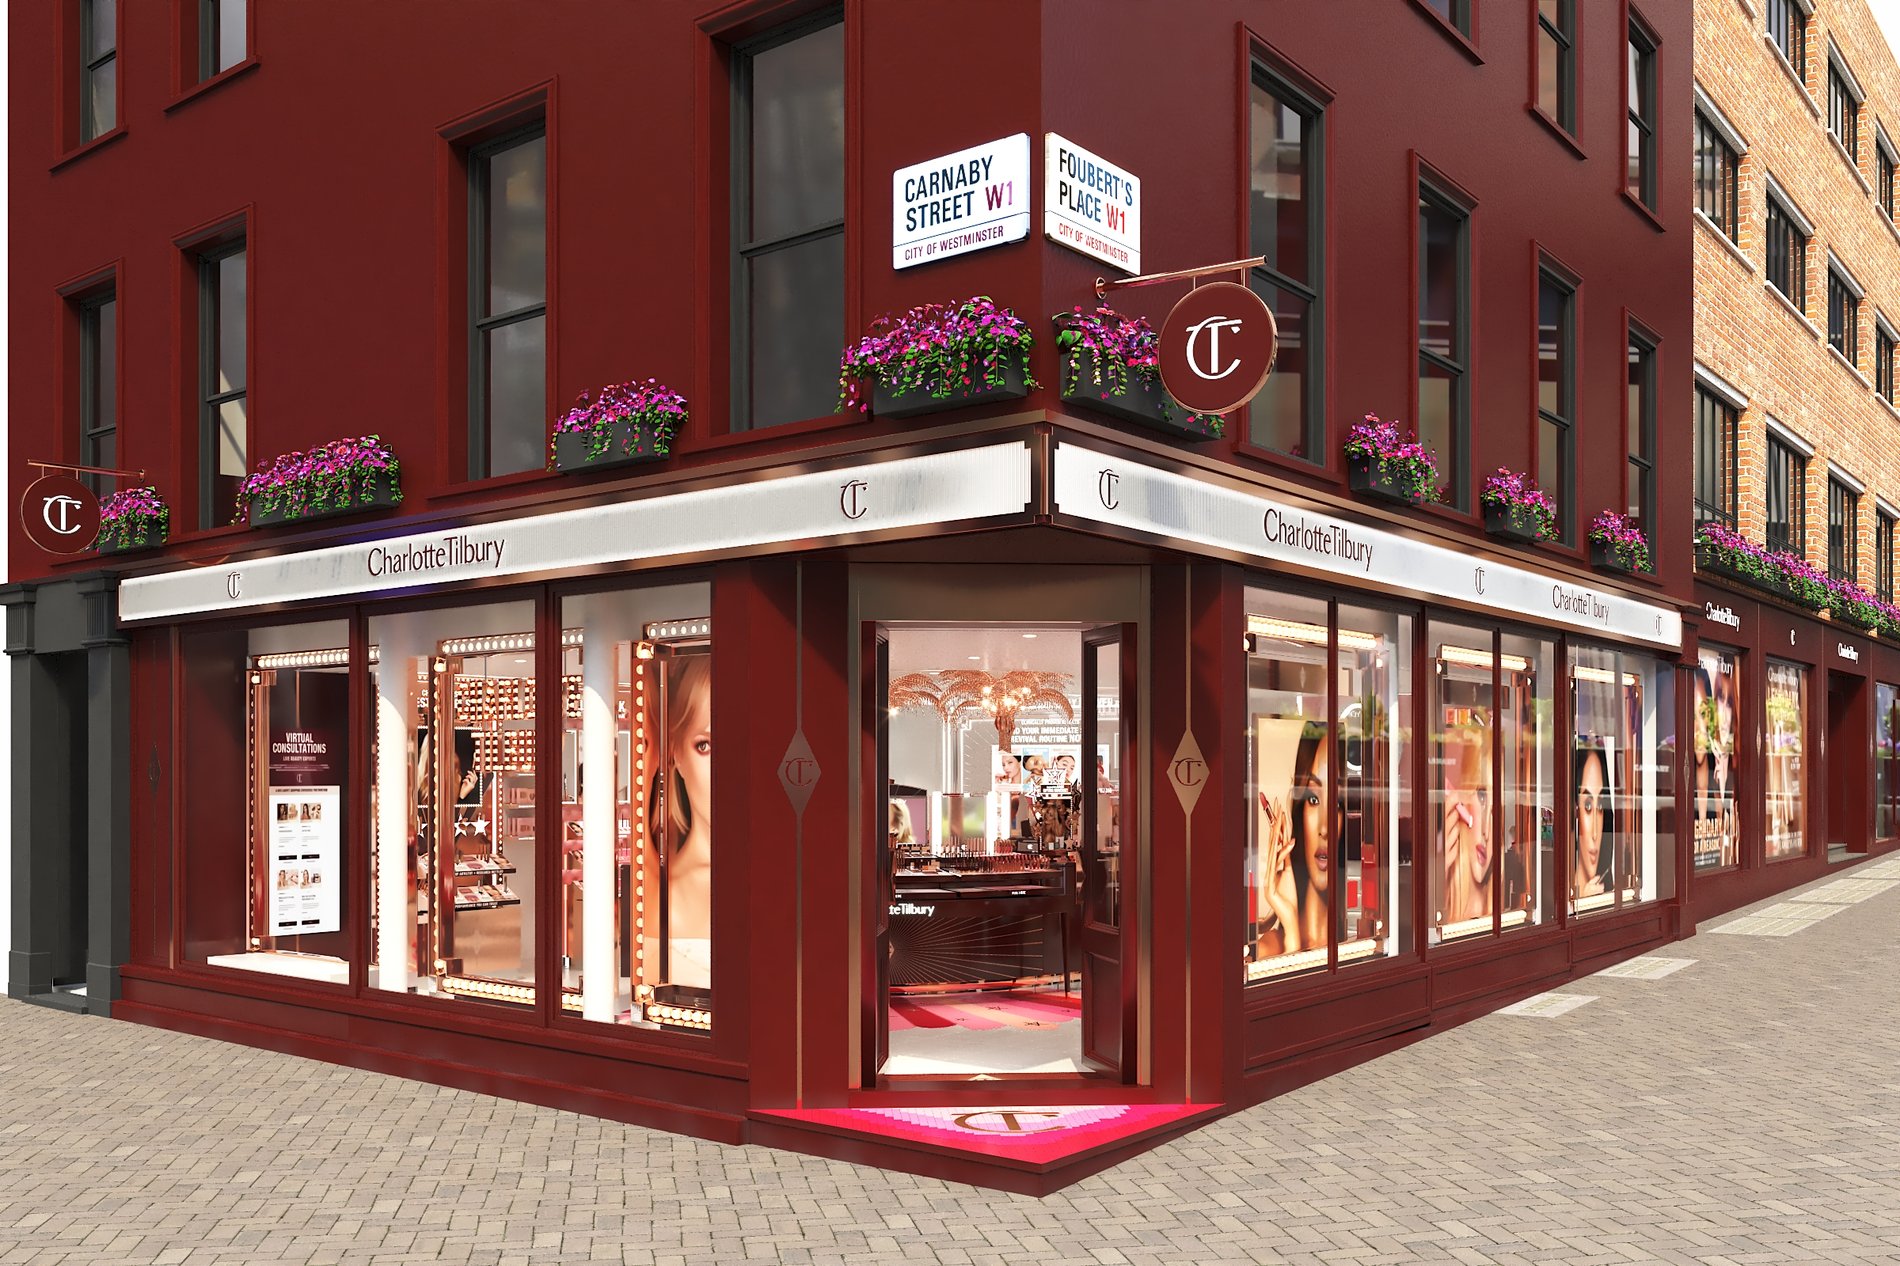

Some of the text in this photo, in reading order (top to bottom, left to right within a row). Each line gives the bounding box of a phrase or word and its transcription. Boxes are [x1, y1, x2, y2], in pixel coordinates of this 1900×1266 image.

[905, 155, 993, 203] CARNABY
[1059, 148, 1133, 206] FOUBERT'S
[906, 180, 1013, 232] STREET W1
[1059, 181, 1126, 235] PLACE W1
[904, 225, 1004, 261] CITY OF WESTMINSTER
[1058, 222, 1129, 263] CITY OF WESTMINSTER
[272, 742, 327, 754] CONSULTATIONS
[285, 732, 314, 743] VIRTUAL
[1021, 726, 1040, 735] YOUR
[1040, 726, 1079, 735] IMMEDIATE
[1038, 734, 1068, 743] ROUTINE
